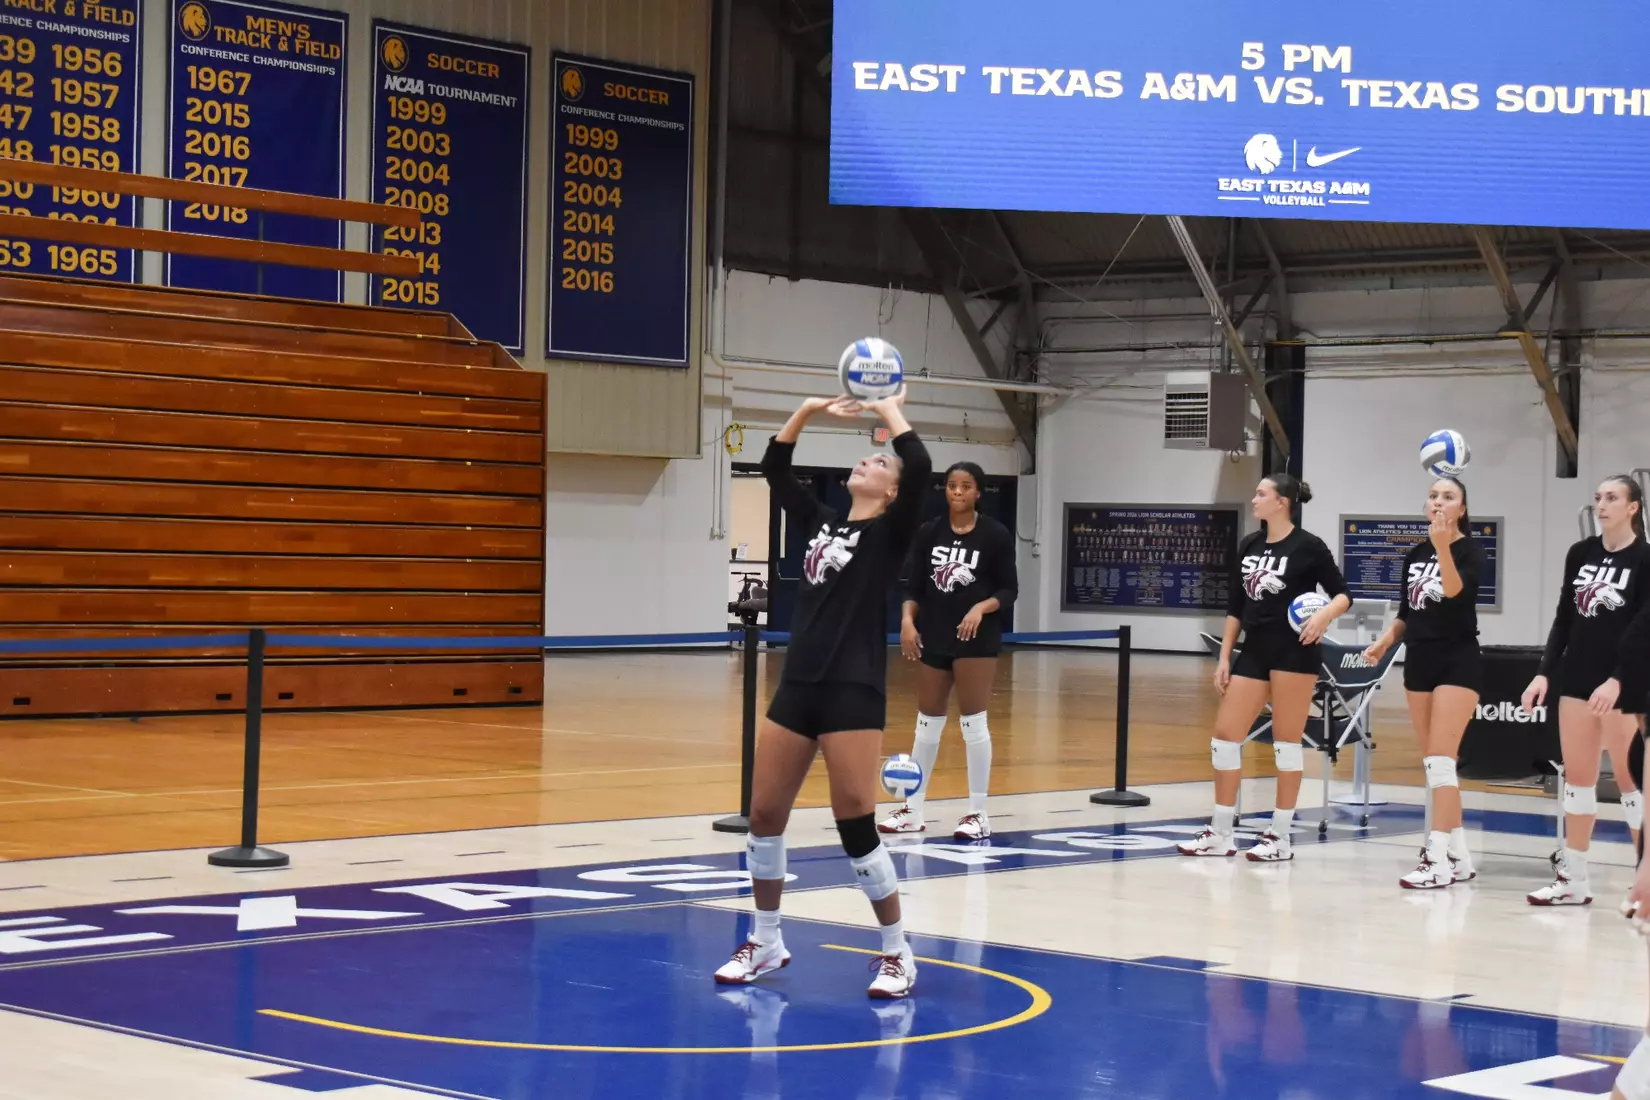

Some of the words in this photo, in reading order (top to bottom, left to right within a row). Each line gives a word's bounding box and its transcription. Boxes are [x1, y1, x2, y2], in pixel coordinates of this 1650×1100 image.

[64, 0, 75, 16] &
[83, 3, 134, 27] FIELD
[246, 15, 311, 40] MEN'S
[36, 20, 130, 43] CHAMPIONSHIPS
[213, 25, 271, 50] TRACK
[277, 36, 289, 52] &
[295, 38, 341, 60] FIELD
[52, 44, 122, 77] 1956
[180, 44, 250, 63] CONFERENCE
[253, 55, 336, 76] CHAMPIONSHIPS
[427, 52, 500, 79] SOCCER
[1241, 42, 1265, 71] 5
[1282, 44, 1352, 74] PM
[51, 78, 120, 109] 1957
[187, 65, 252, 96] 1967
[384, 74, 424, 95] NCAA
[427, 83, 518, 108] TOURNAMENT
[603, 82, 669, 106] SOCCER
[852, 61, 966, 93] EAST
[982, 66, 1124, 99] TEXAS
[1139, 71, 1237, 103] A&M
[1254, 75, 1324, 107] VS.
[1341, 78, 1480, 112] TEXAS
[186, 97, 250, 129] 2015
[388, 96, 447, 125] 1999
[561, 104, 616, 121] CONFERENCE
[618, 113, 685, 131] CHAMPIONSHIPS
[50, 111, 120, 143] 1958
[386, 125, 451, 157] 2003
[566, 123, 619, 151] 1999
[50, 144, 120, 173] 1959
[185, 129, 250, 160] 2016
[185, 162, 249, 188] 2017
[385, 156, 450, 186] 2004
[564, 152, 622, 181] 2003
[563, 181, 622, 209] 2004
[1218, 178, 1265, 193] EAST
[1267, 179, 1326, 195] TEXAS
[1329, 181, 1371, 196] A&M
[1263, 194, 1326, 207] VOLLEYBALL
[384, 187, 449, 216] 2008
[563, 210, 615, 236] 2014
[47, 245, 118, 275] 1965
[562, 238, 614, 265] 2015
[382, 278, 440, 306] 2015
[562, 267, 614, 293] 2016
[858, 361, 894, 371] molten
[930, 545, 980, 570] SIU
[1241, 555, 1288, 576] SIU
[1573, 564, 1631, 590] SIU
